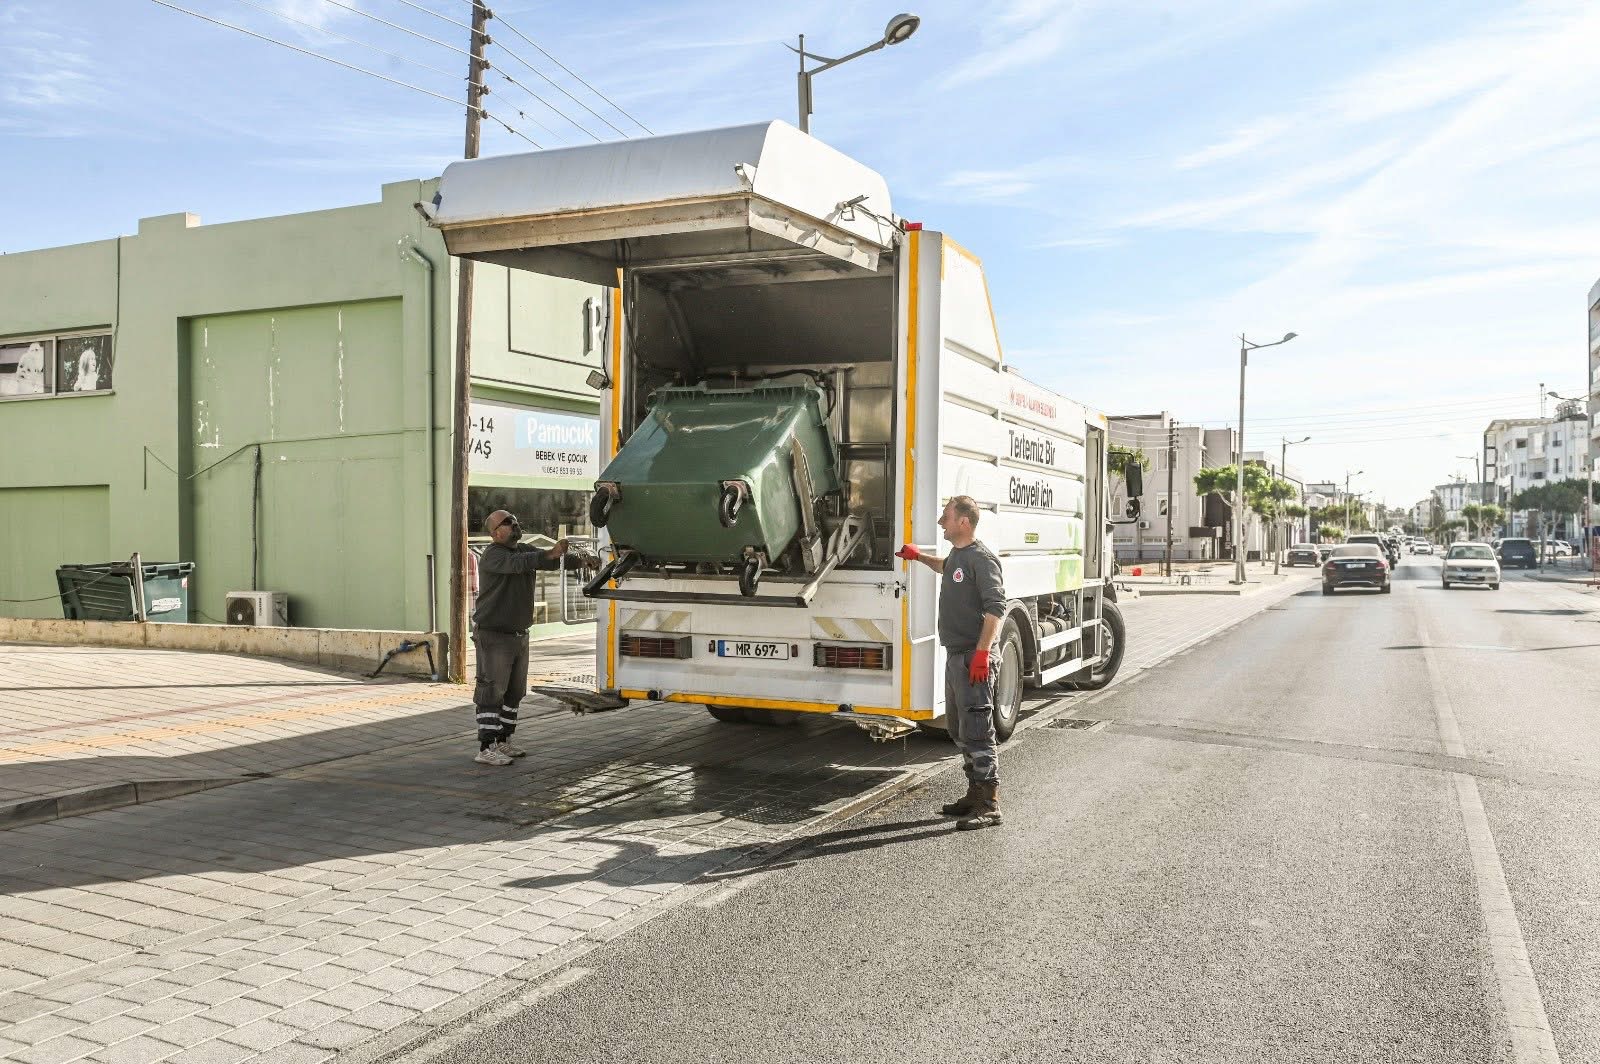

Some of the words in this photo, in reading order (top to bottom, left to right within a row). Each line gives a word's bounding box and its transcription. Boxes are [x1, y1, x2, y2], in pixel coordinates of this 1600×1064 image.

[527, 416, 593, 446] Pamucuk
[535, 450, 556, 461] BEBEK
[557, 452, 566, 461] VE
[567, 453, 588, 463] ÇOCUK
[1008, 429, 1044, 464] Tertemiz
[1045, 439, 1056, 466] Bir
[1009, 475, 1040, 509] Gönyeli
[736, 643, 751, 656] MR
[754, 644, 777, 657] 697
